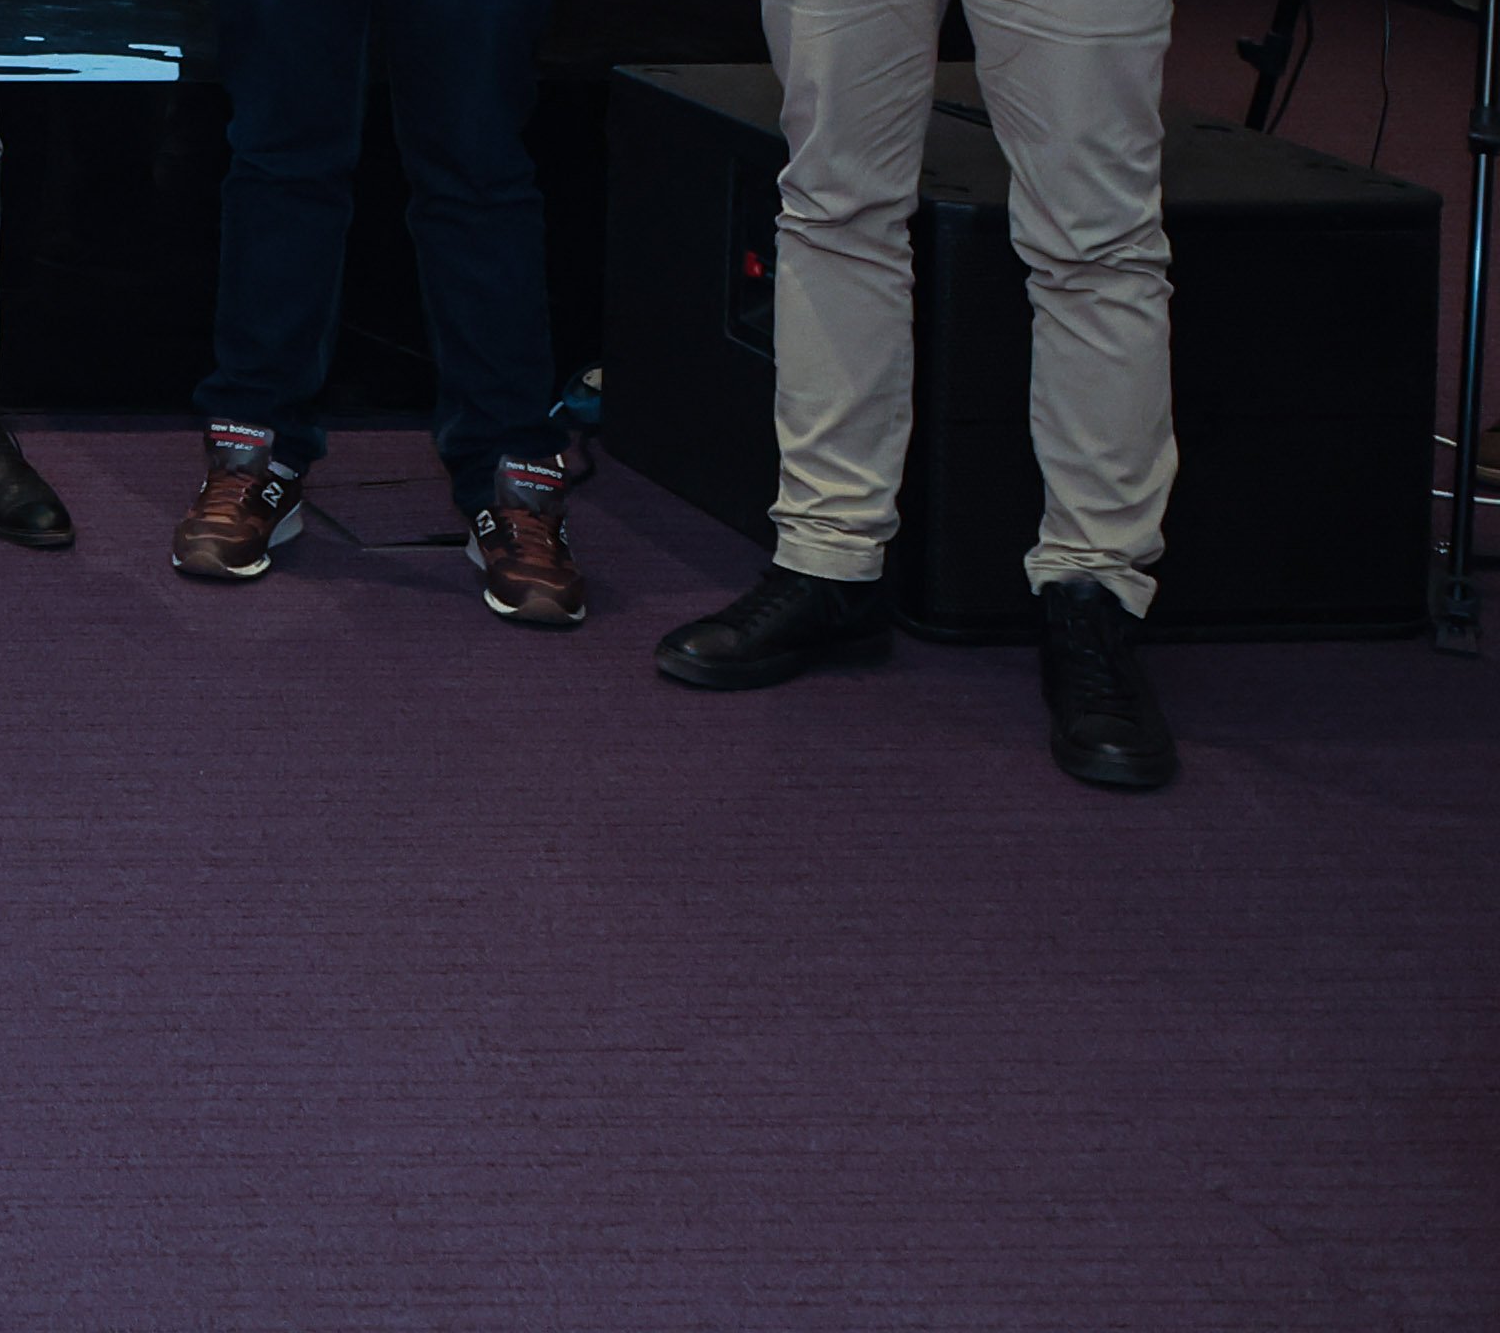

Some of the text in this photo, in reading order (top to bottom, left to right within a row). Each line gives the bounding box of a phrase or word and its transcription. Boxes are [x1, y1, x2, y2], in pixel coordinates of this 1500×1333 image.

[229, 423, 266, 438] balance
[505, 460, 563, 480] new balance
